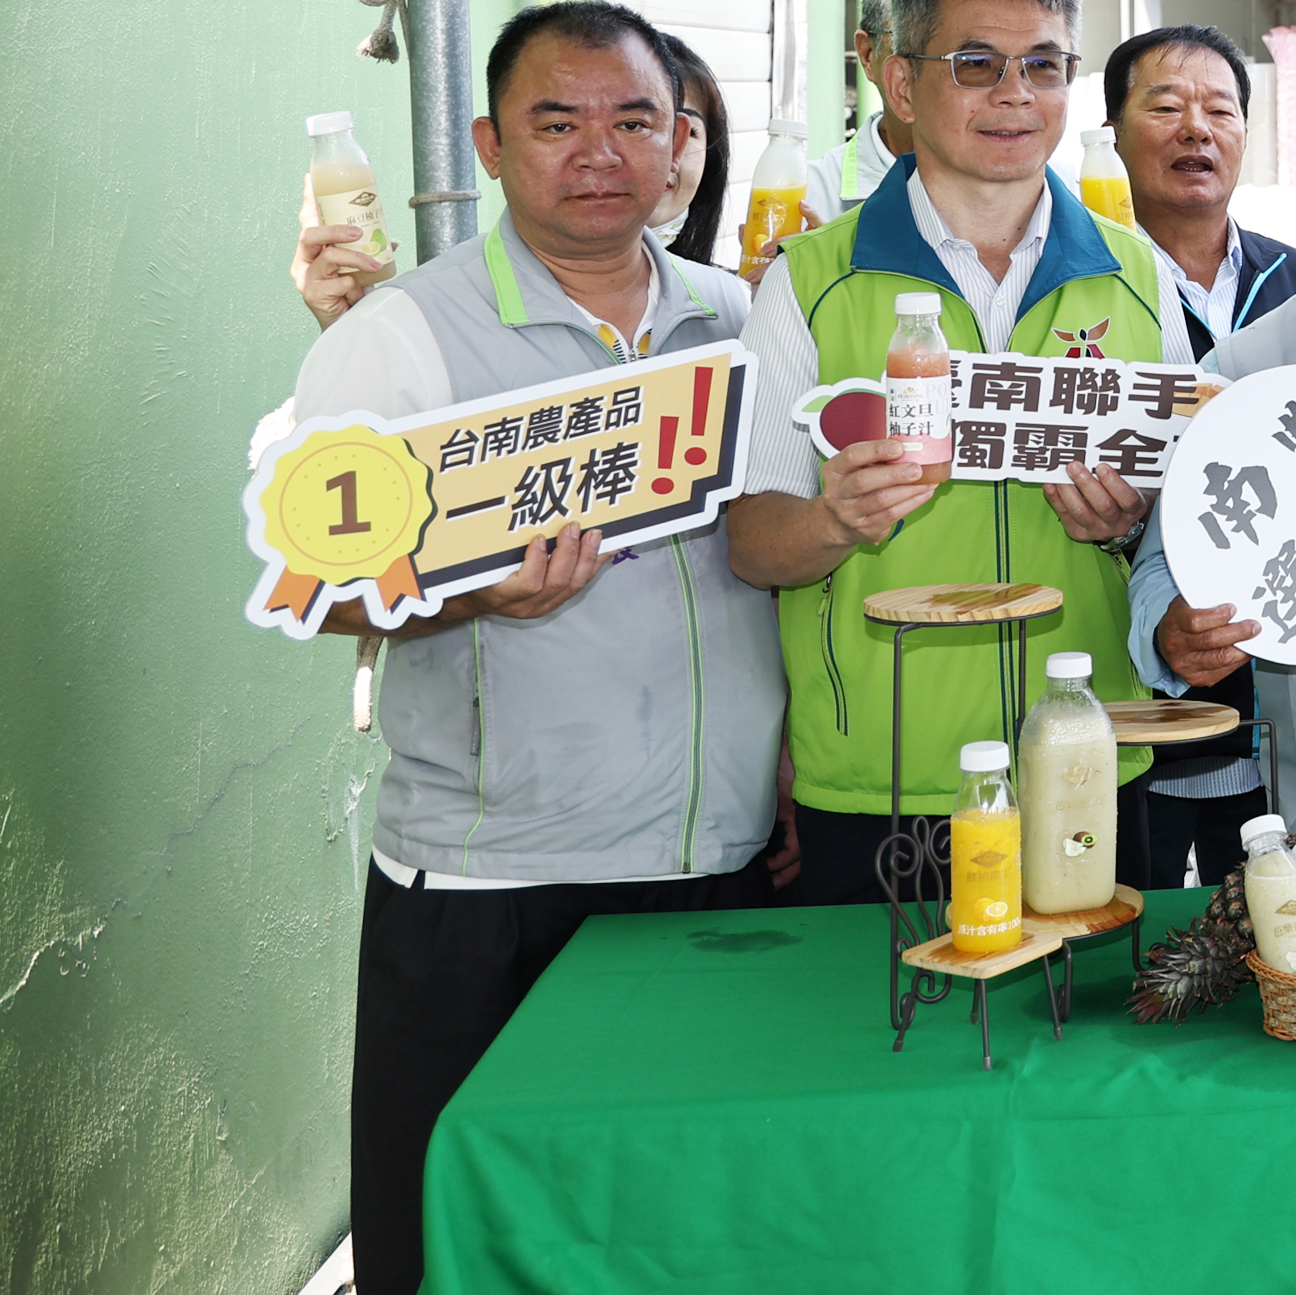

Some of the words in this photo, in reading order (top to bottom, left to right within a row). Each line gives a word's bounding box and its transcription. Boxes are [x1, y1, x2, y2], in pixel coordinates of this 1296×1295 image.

[889, 403, 934, 418] 紅文旦
[950, 360, 1199, 420] 南聯手
[438, 386, 642, 473] 台南農產品
[889, 421, 934, 436] 柚子汁
[951, 418, 1179, 477] 獨霸全
[325, 470, 372, 536] 1
